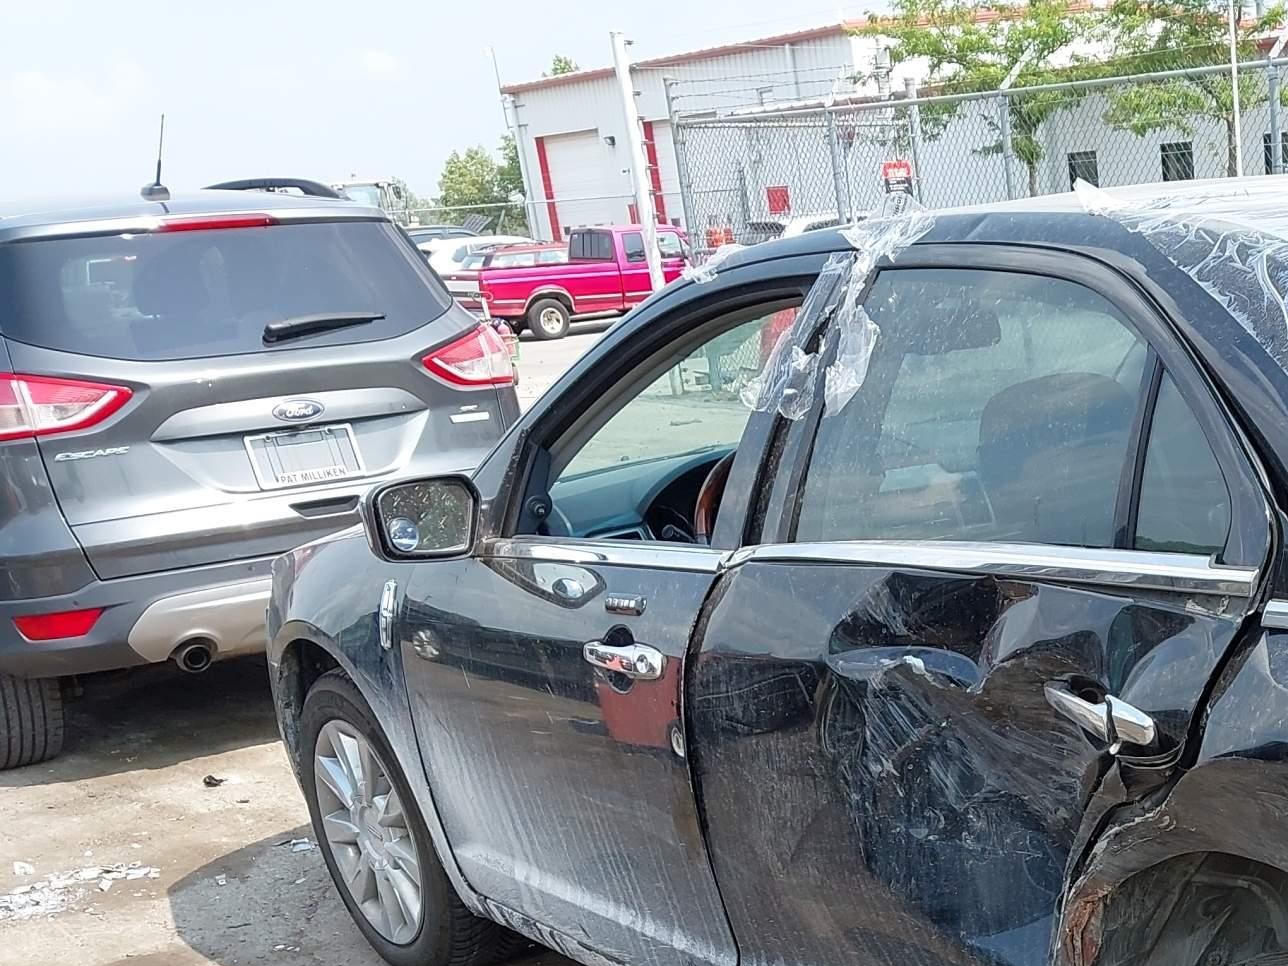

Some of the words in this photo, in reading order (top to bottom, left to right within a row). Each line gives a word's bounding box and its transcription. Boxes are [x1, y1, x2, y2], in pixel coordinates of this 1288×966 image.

[54, 446, 130, 461] ESCAPE
[280, 474, 297, 484] PAT
[301, 467, 346, 482] MILLIKEN
